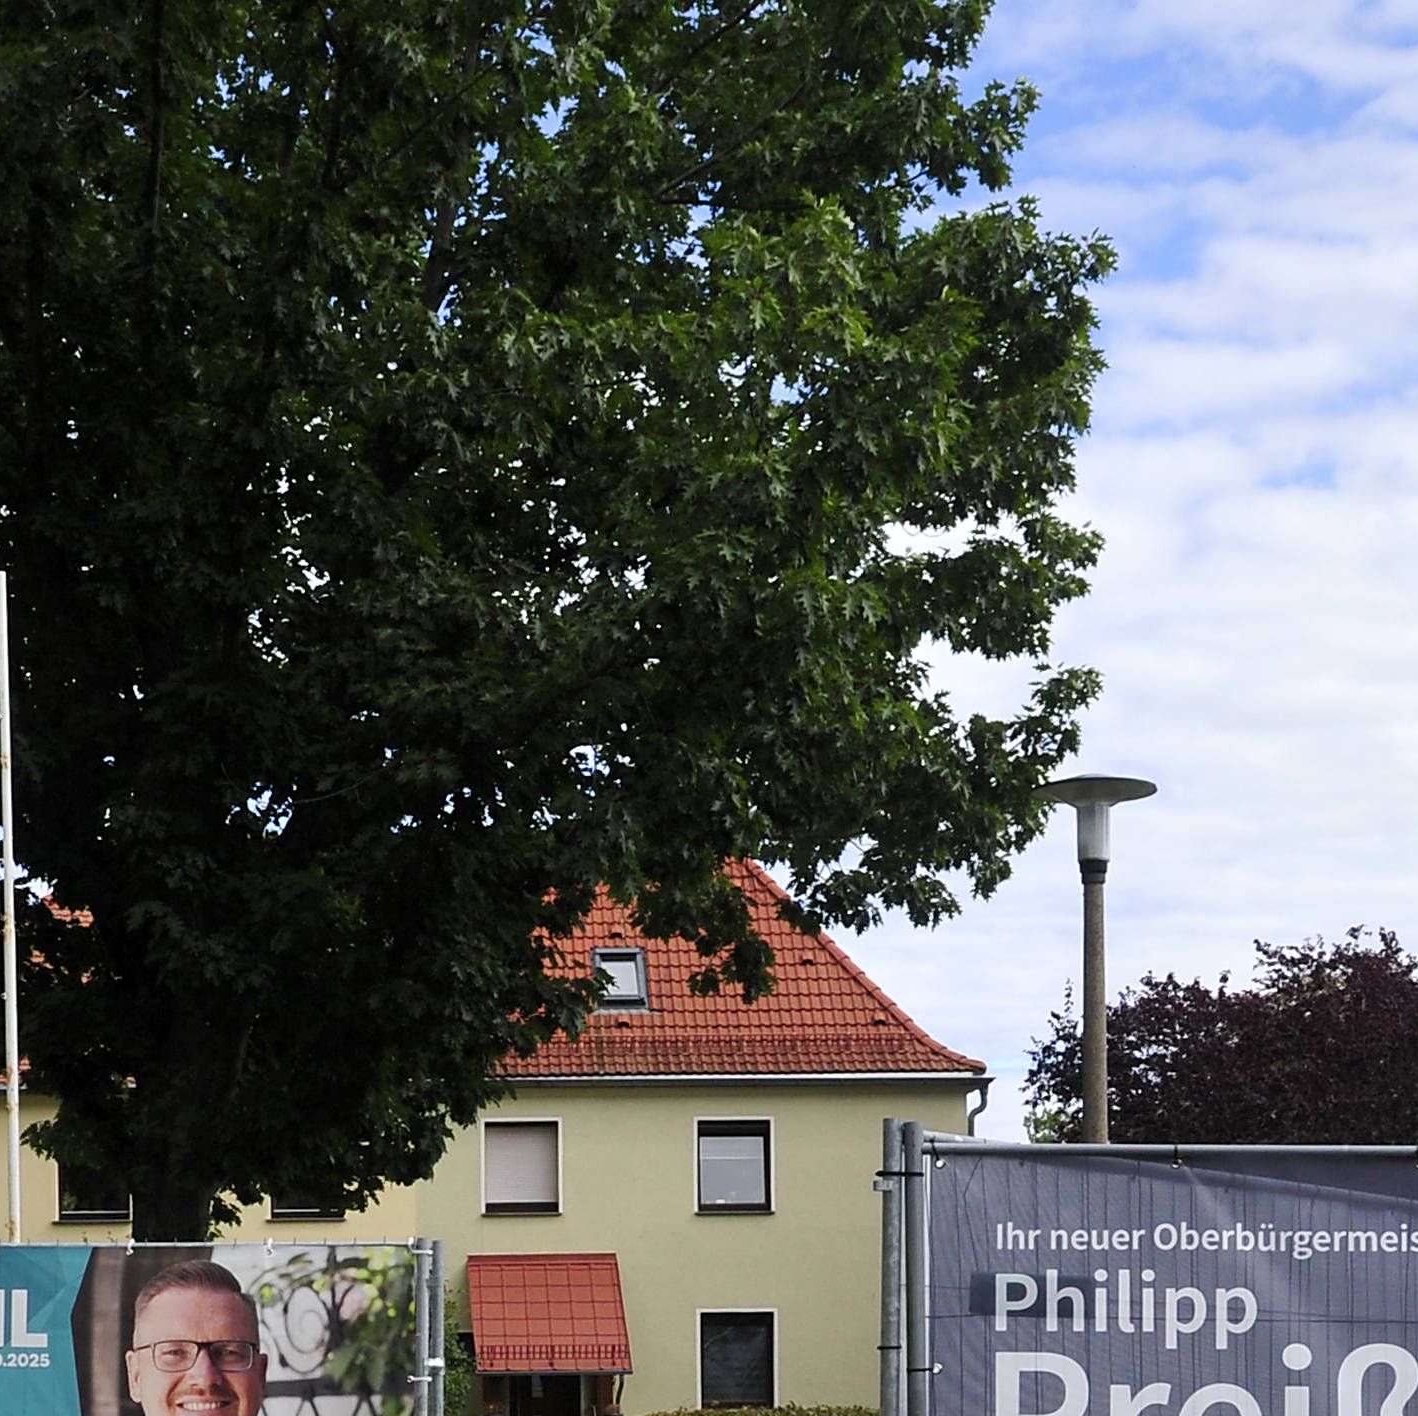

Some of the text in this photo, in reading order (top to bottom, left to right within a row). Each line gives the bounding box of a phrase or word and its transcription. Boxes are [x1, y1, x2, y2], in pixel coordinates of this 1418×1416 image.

[995, 1222, 1042, 1251] Ihr
[1049, 1226, 1145, 1251] neuer
[995, 1269, 1259, 1349] Philipp
